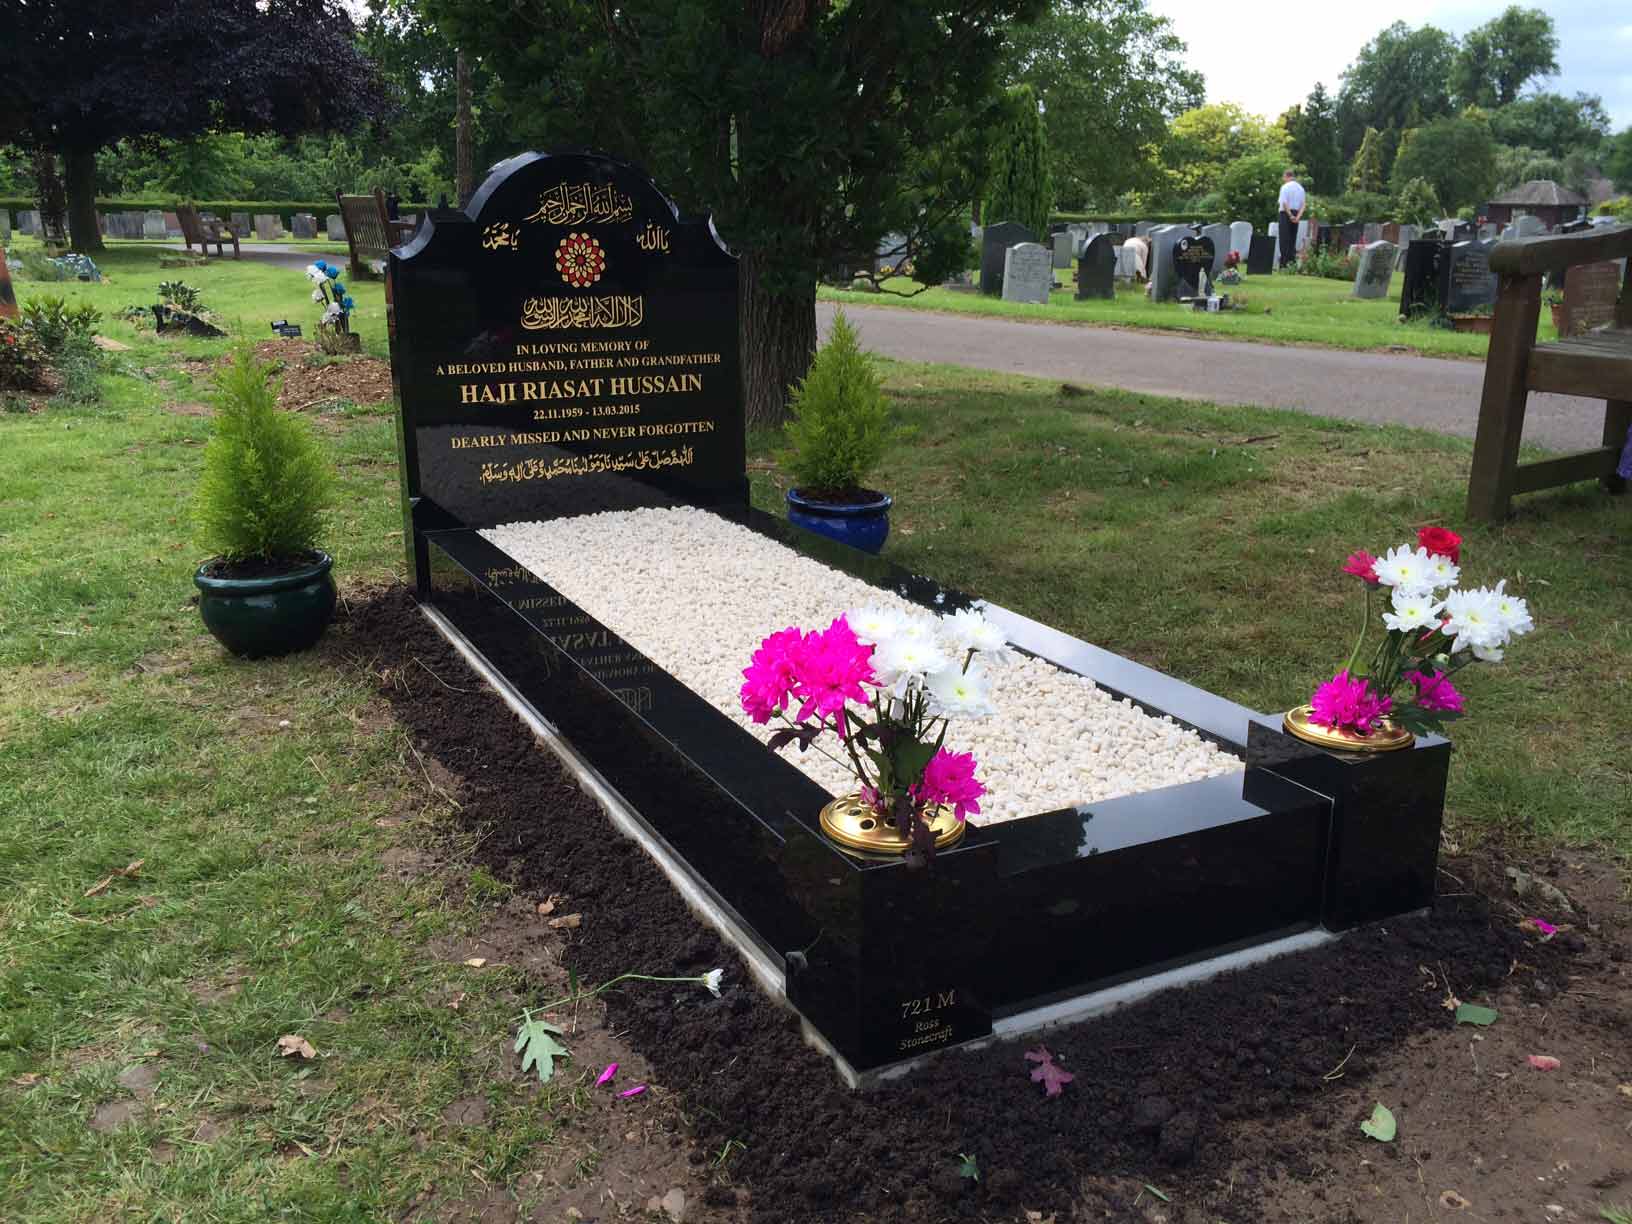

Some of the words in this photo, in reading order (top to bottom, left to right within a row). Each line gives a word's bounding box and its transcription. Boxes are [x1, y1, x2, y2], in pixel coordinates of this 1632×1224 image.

[516, 344, 529, 355] IN
[532, 342, 578, 355] LOVING
[580, 341, 632, 353] MEMORY
[634, 340, 650, 350] OF
[435, 365, 445, 376] A
[447, 362, 506, 375] BELOVED
[508, 359, 568, 372] HUSBAND,
[569, 358, 614, 370] FATHER
[616, 358, 640, 368] AND
[641, 353, 721, 367] GRANDFATHER
[460, 383, 517, 404] HAJI
[523, 378, 605, 401] RIASAT
[609, 373, 703, 396] HUSSAIN
[533, 407, 583, 420] 22.11.1959
[592, 404, 641, 417] 13.03.2015
[450, 434, 508, 449] DEARLY
[510, 430, 560, 445] MISSED
[562, 428, 591, 442] AND
[592, 426, 637, 440] NEVER
[639, 420, 716, 437] FORGOTTEN
[901, 997, 932, 1018] 721
[937, 989, 955, 1009] M
[899, 1024, 953, 1050] Stonecraft
[915, 1018, 939, 1033] Ross
